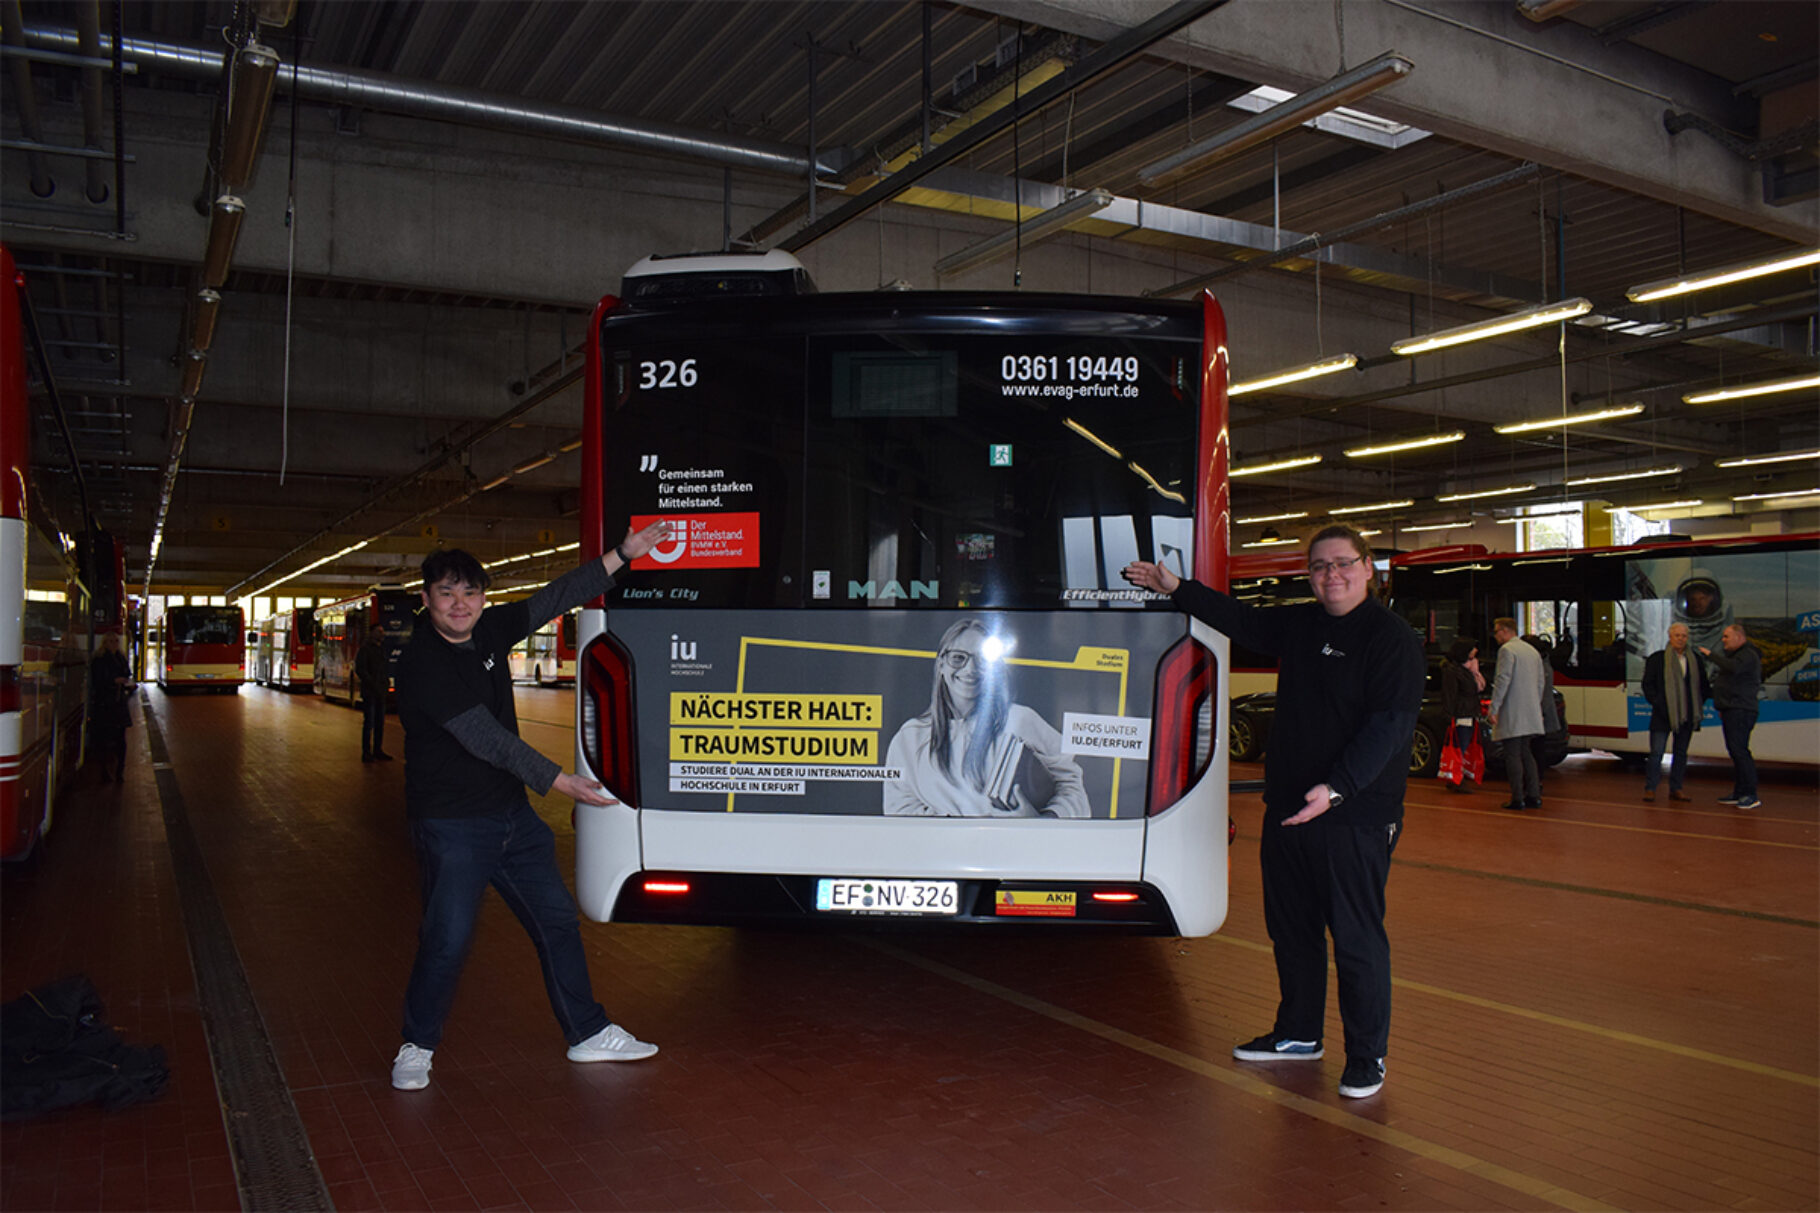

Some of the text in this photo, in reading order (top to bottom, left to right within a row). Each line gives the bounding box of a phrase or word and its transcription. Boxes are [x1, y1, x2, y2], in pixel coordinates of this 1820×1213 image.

[639, 358, 699, 389] 326
[1001, 355, 1139, 382] 0361 19449
[1001, 383, 1140, 400] www.evag-erfurt.de
[658, 468, 725, 480] Gemeinsam
[658, 481, 753, 494] für einen starken
[658, 496, 724, 508] Mittelstand.
[690, 520, 707, 531] Der
[690, 529, 744, 541] Mittelstand.
[623, 587, 700, 601] Lion's City
[847, 580, 940, 599] MAN
[671, 634, 697, 661] iu
[680, 695, 872, 722] NÄCHSTER HALT:
[1072, 722, 1138, 735] INFOS UNTER
[680, 734, 868, 757] TRAUMSTUDIUM
[1071, 736, 1143, 750] IU.DE/ERFURT
[680, 765, 901, 779] STUDIERE DUAL AN DER IU INTERNATIONALEN
[680, 780, 801, 792] HOCHSCHULE IN ERFURT
[832, 883, 954, 907] EF NV 326
[1046, 893, 1073, 903] AKH
